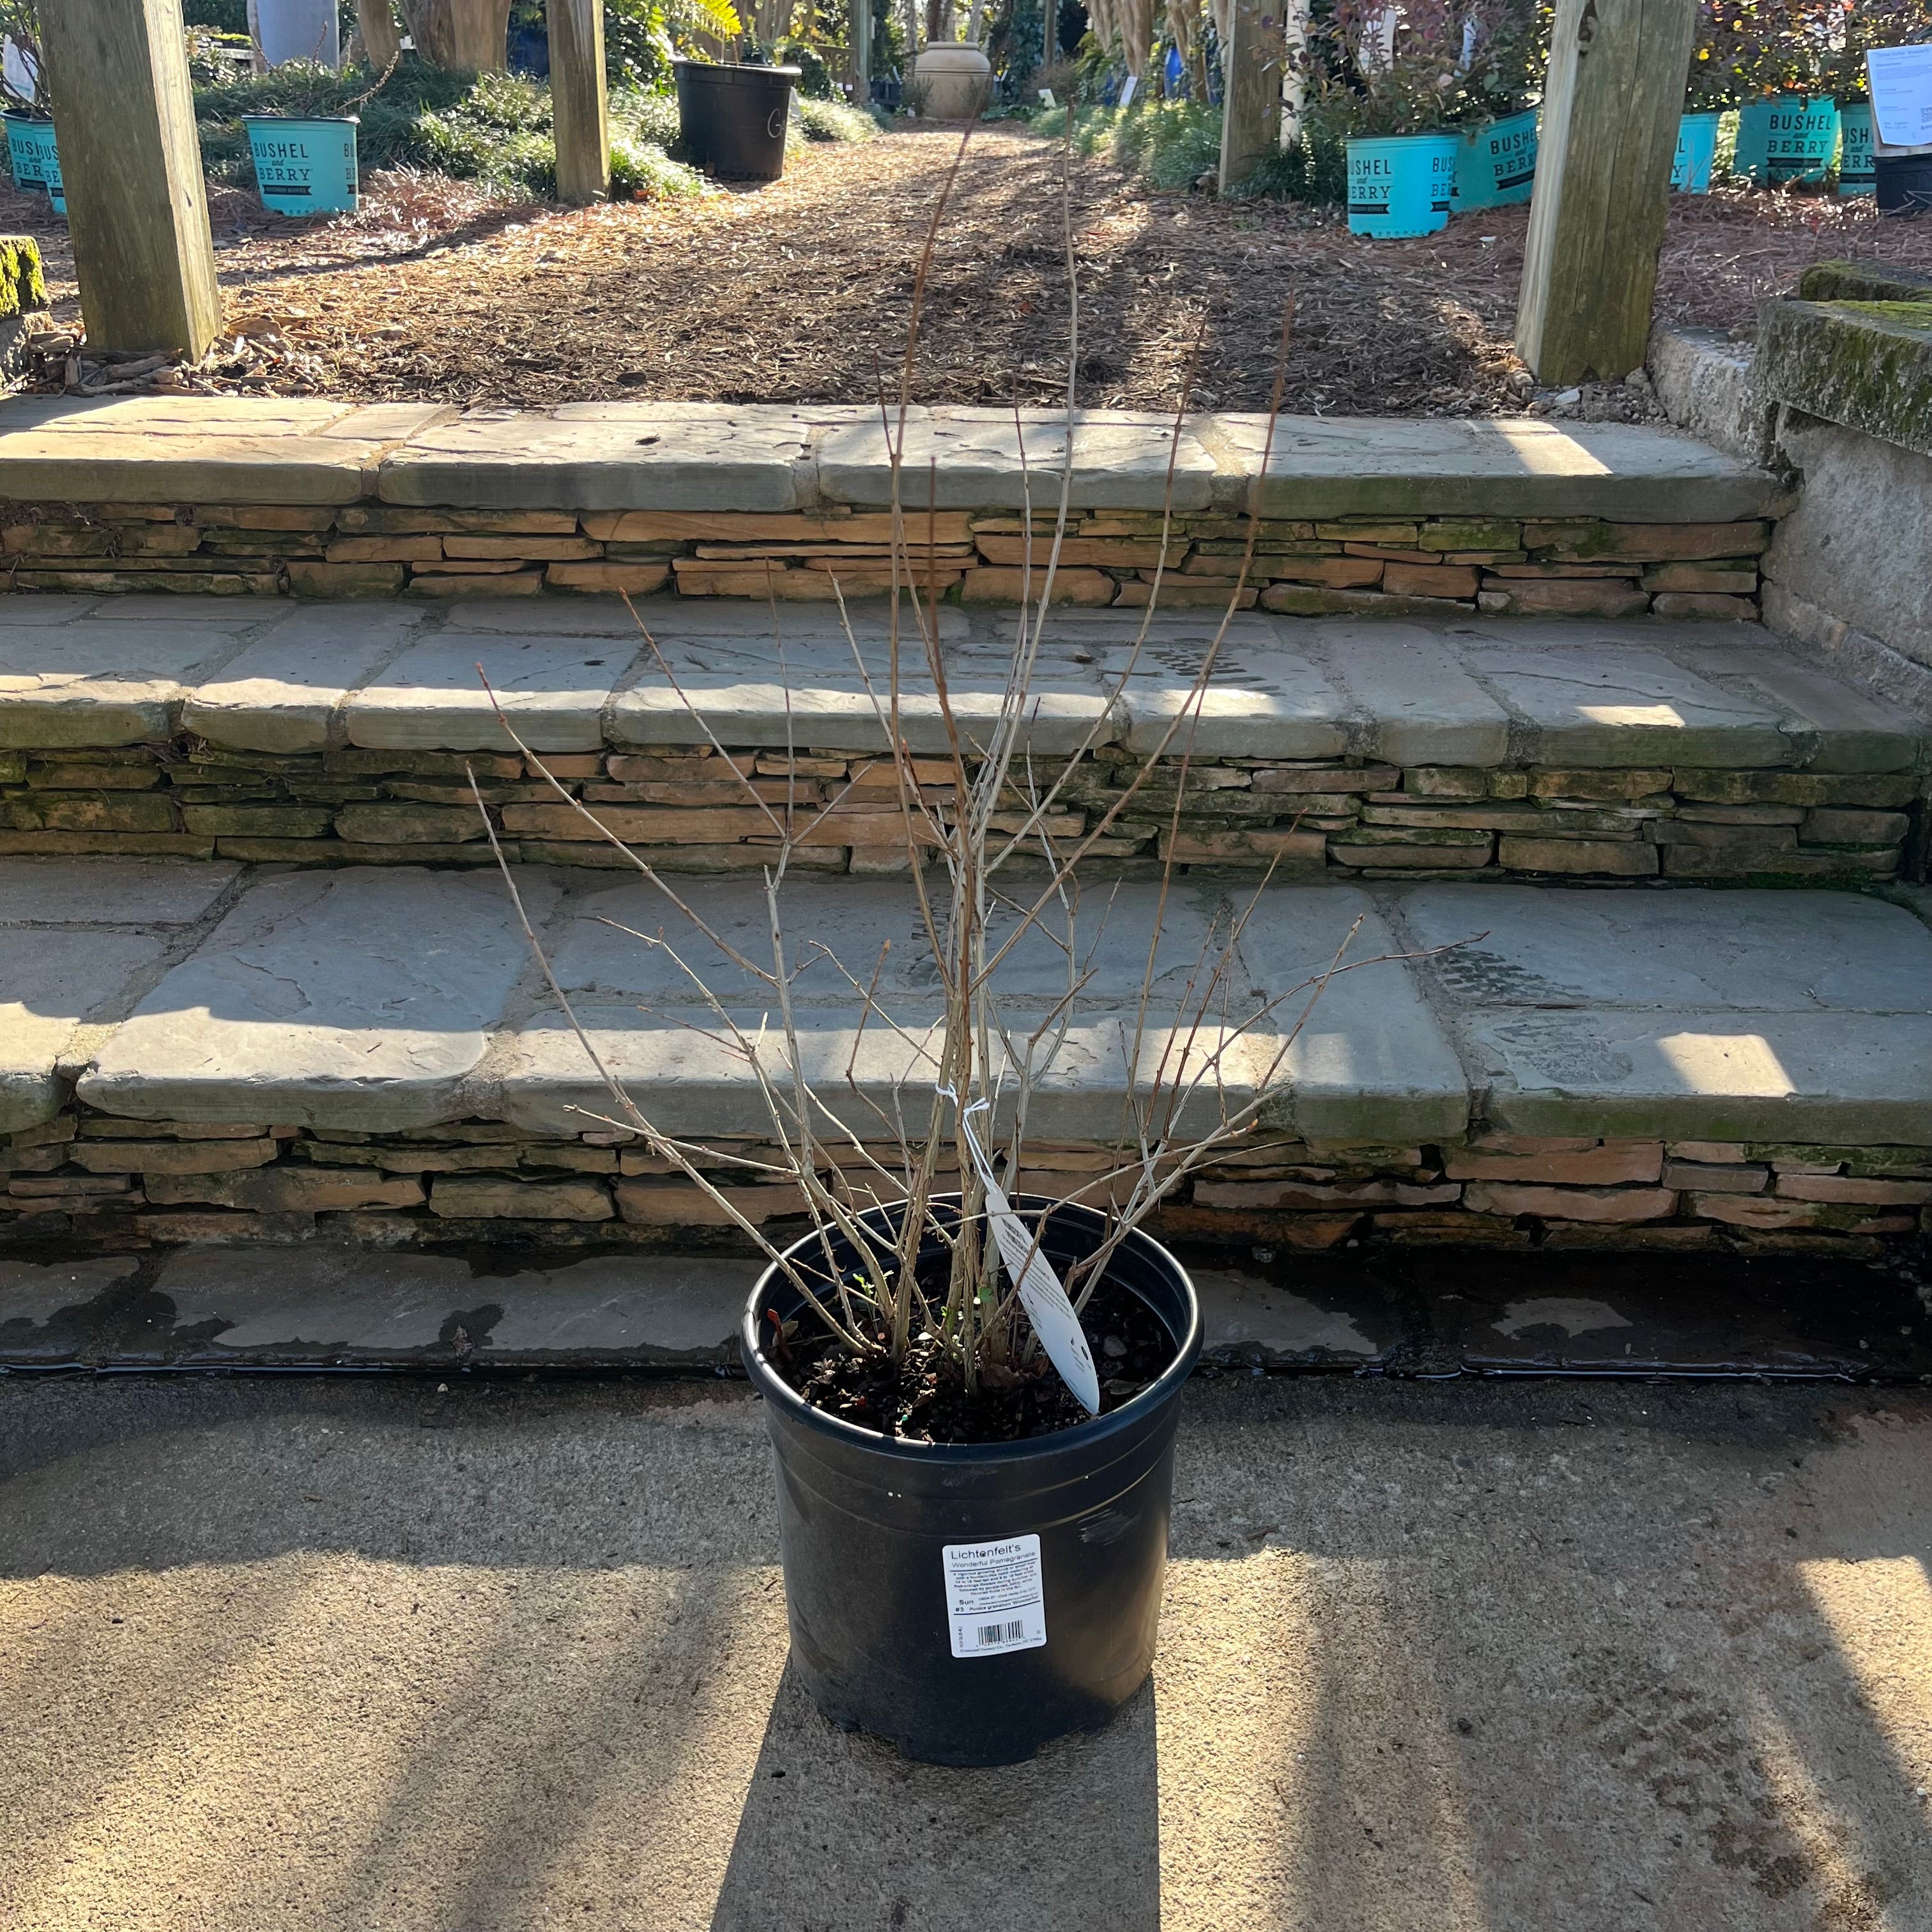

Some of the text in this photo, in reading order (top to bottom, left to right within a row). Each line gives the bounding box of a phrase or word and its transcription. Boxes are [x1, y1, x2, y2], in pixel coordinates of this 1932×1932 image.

[1770, 114, 1832, 130] BUSHEL
[1491, 128, 1535, 155] BUSHE
[1767, 141, 1830, 153] BERRY
[254, 142, 309, 158] BUSHEL
[1349, 159, 1392, 175] USHEL
[1494, 154, 1534, 176] BERR
[258, 167, 310, 181] BERRY
[1348, 185, 1392, 199] ERRY
[951, 1544, 1021, 1560] Lichtenfelt's
[990, 1552, 1036, 1565] Pomegranate
